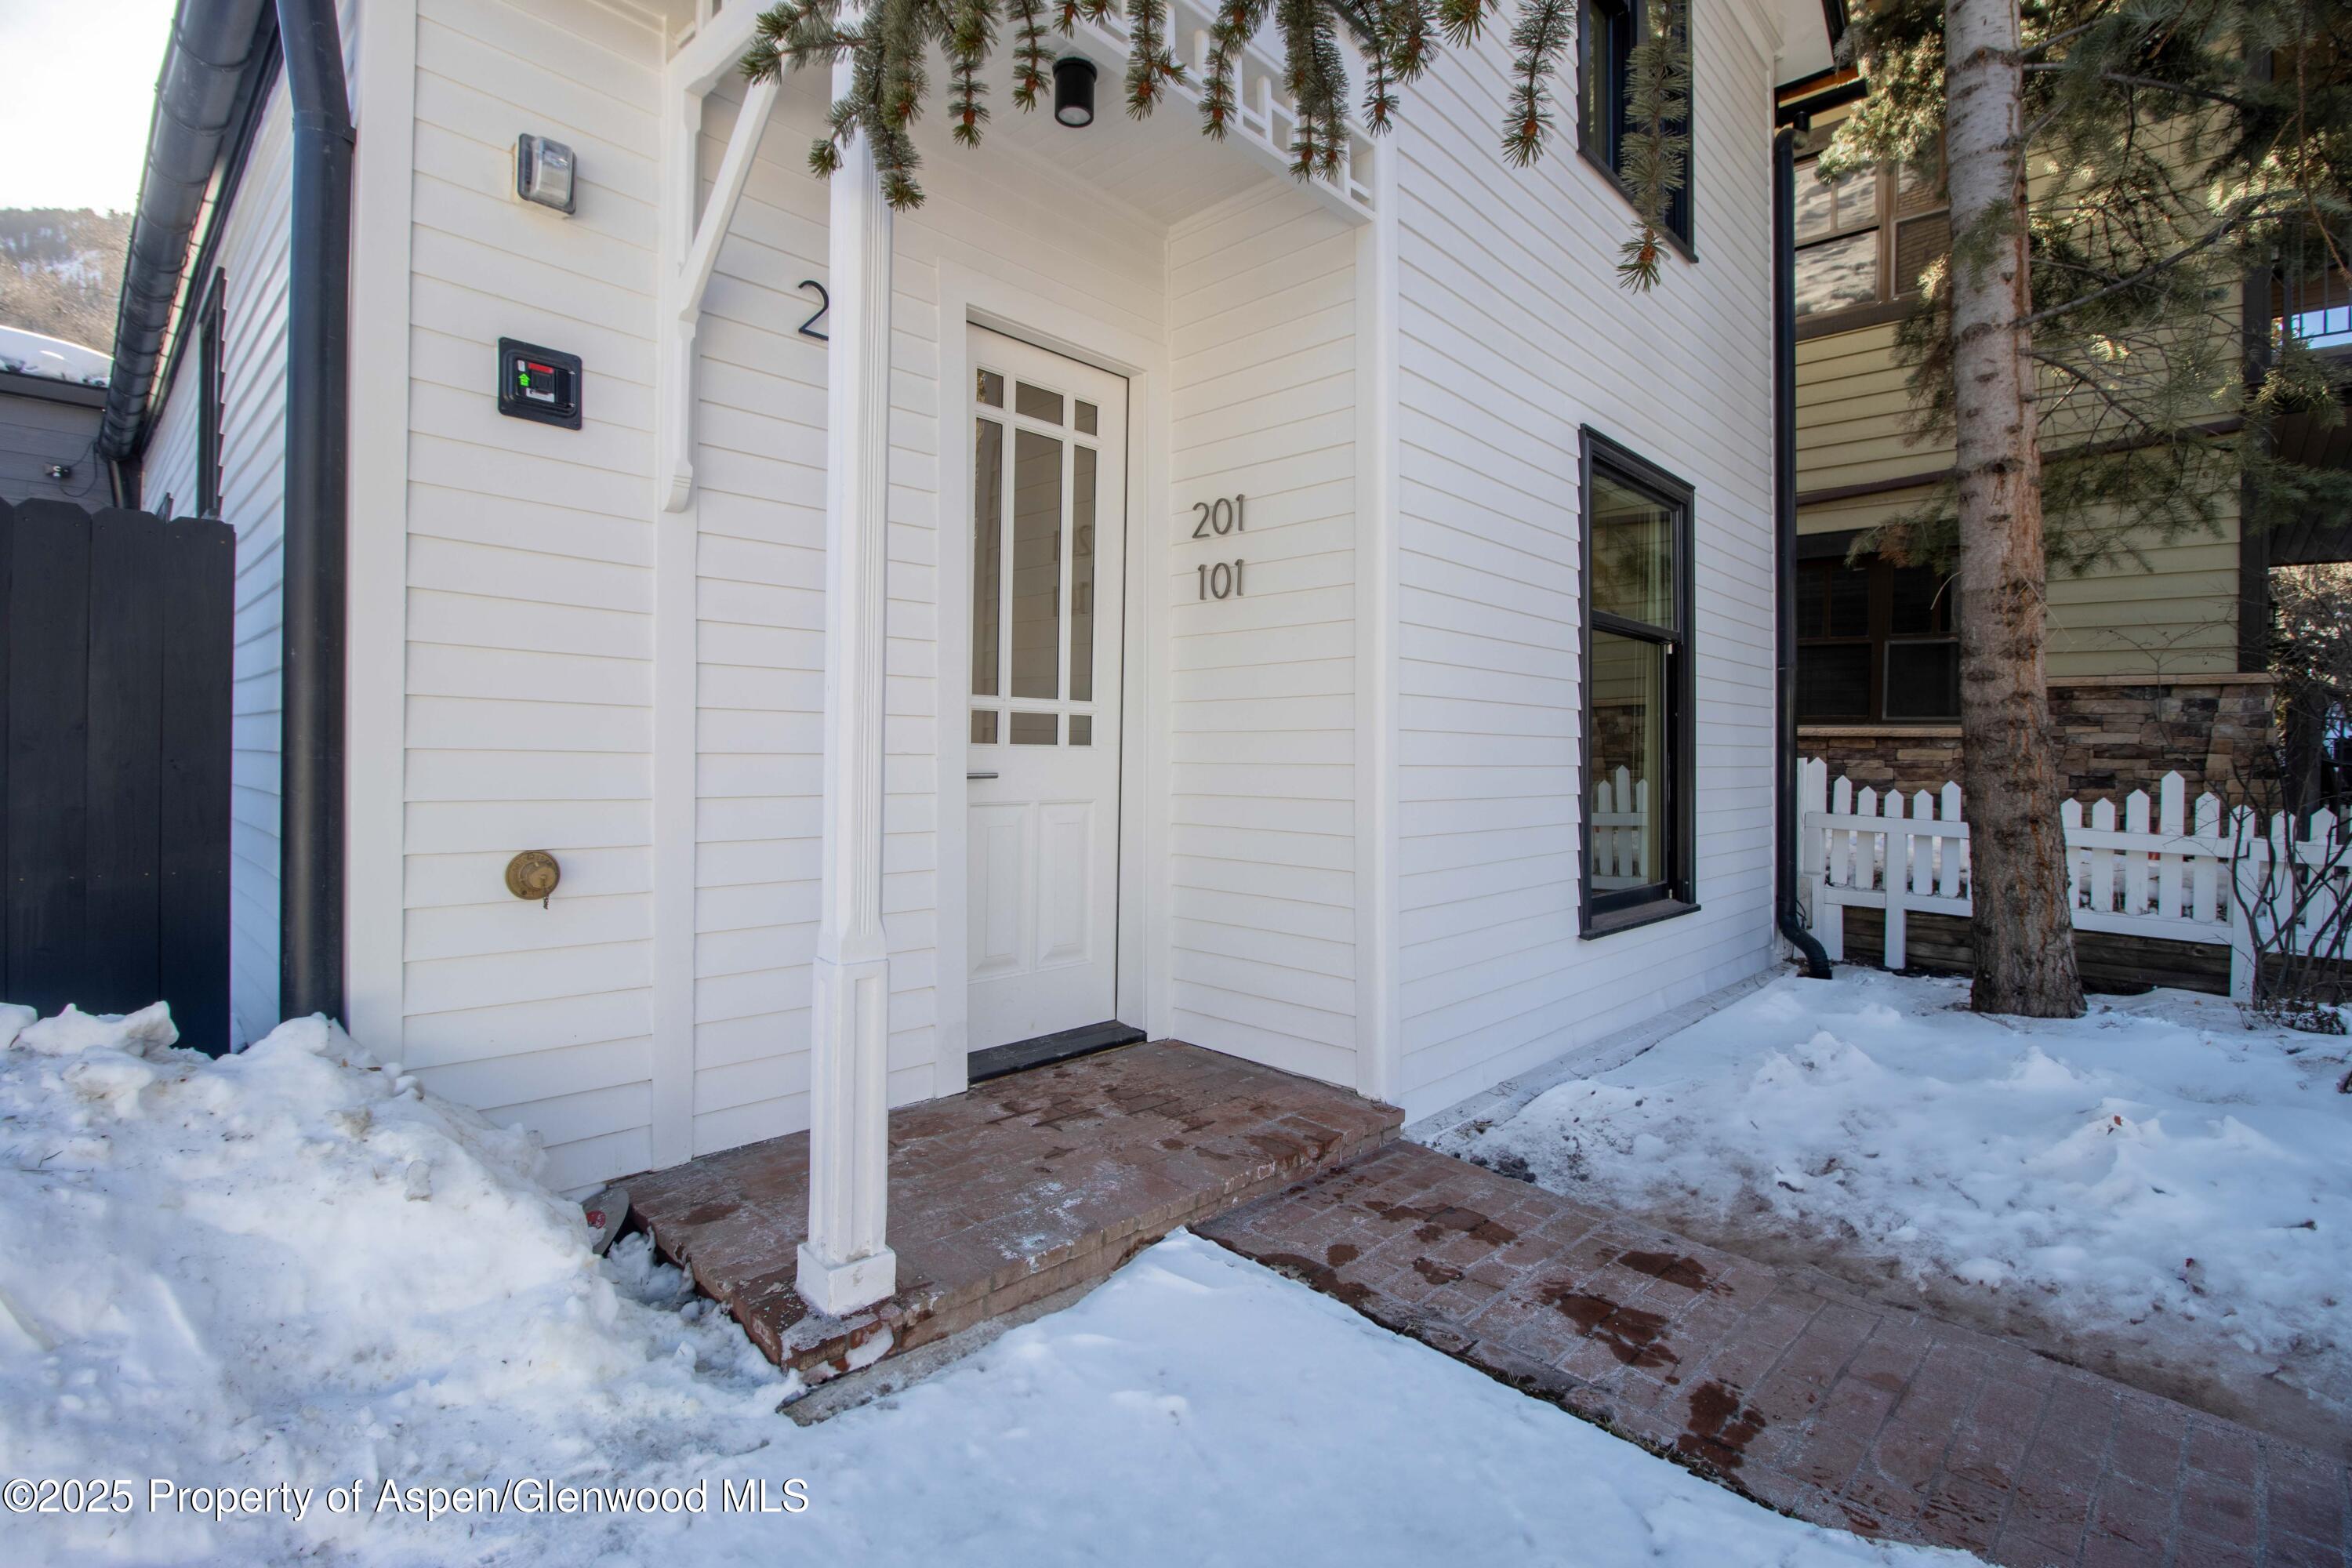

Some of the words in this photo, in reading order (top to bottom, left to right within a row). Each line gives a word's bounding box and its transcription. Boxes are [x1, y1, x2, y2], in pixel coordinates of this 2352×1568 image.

[798, 280, 829, 341] 2
[1192, 494, 1245, 539] 201
[1198, 559, 1244, 600] 101
